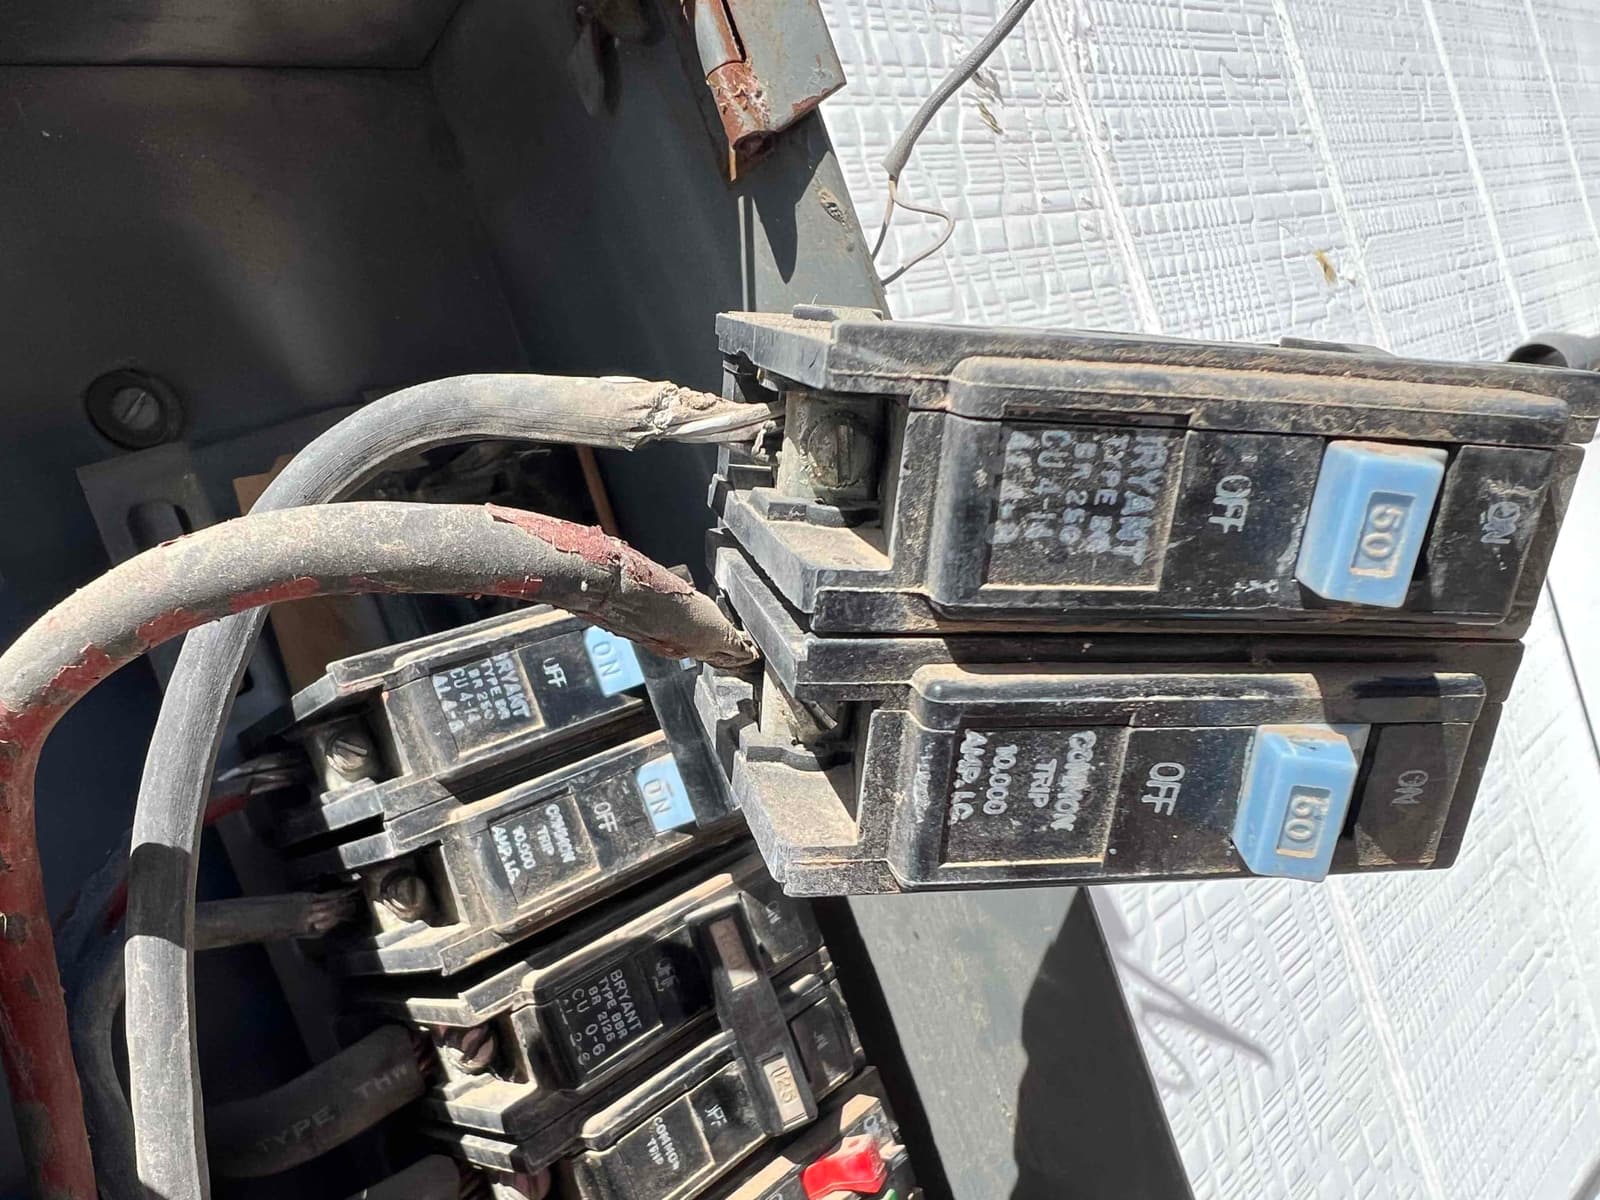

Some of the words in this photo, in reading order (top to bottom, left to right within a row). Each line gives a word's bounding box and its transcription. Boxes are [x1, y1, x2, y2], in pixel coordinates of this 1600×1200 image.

[1037, 430, 1072, 468] CU
[1208, 474, 1251, 534] OFF
[1480, 501, 1521, 545] ON
[1361, 504, 1403, 559] 50
[450, 668, 469, 689] CU
[480, 658, 503, 696] TYPE
[591, 640, 621, 677] ON
[468, 668, 484, 689] BR
[476, 692, 495, 721] 250
[643, 777, 673, 815] ON
[1028, 759, 1057, 808] TRIP
[1050, 730, 1098, 831] COMMON
[1141, 761, 1186, 816] OFF
[1390, 770, 1429, 806] ON
[545, 803, 576, 863] COMMON
[593, 801, 618, 833] OFF
[536, 824, 554, 856] TRIP
[588, 986, 602, 1005] BR
[599, 976, 617, 1009] TYPE
[610, 969, 643, 1031] BRYANT
[572, 988, 590, 1014] CU
[585, 1023, 606, 1056] 0-6
[770, 1065, 798, 1103] 125
[256, 1105, 335, 1152] TYPE
[352, 1063, 408, 1099] THW
